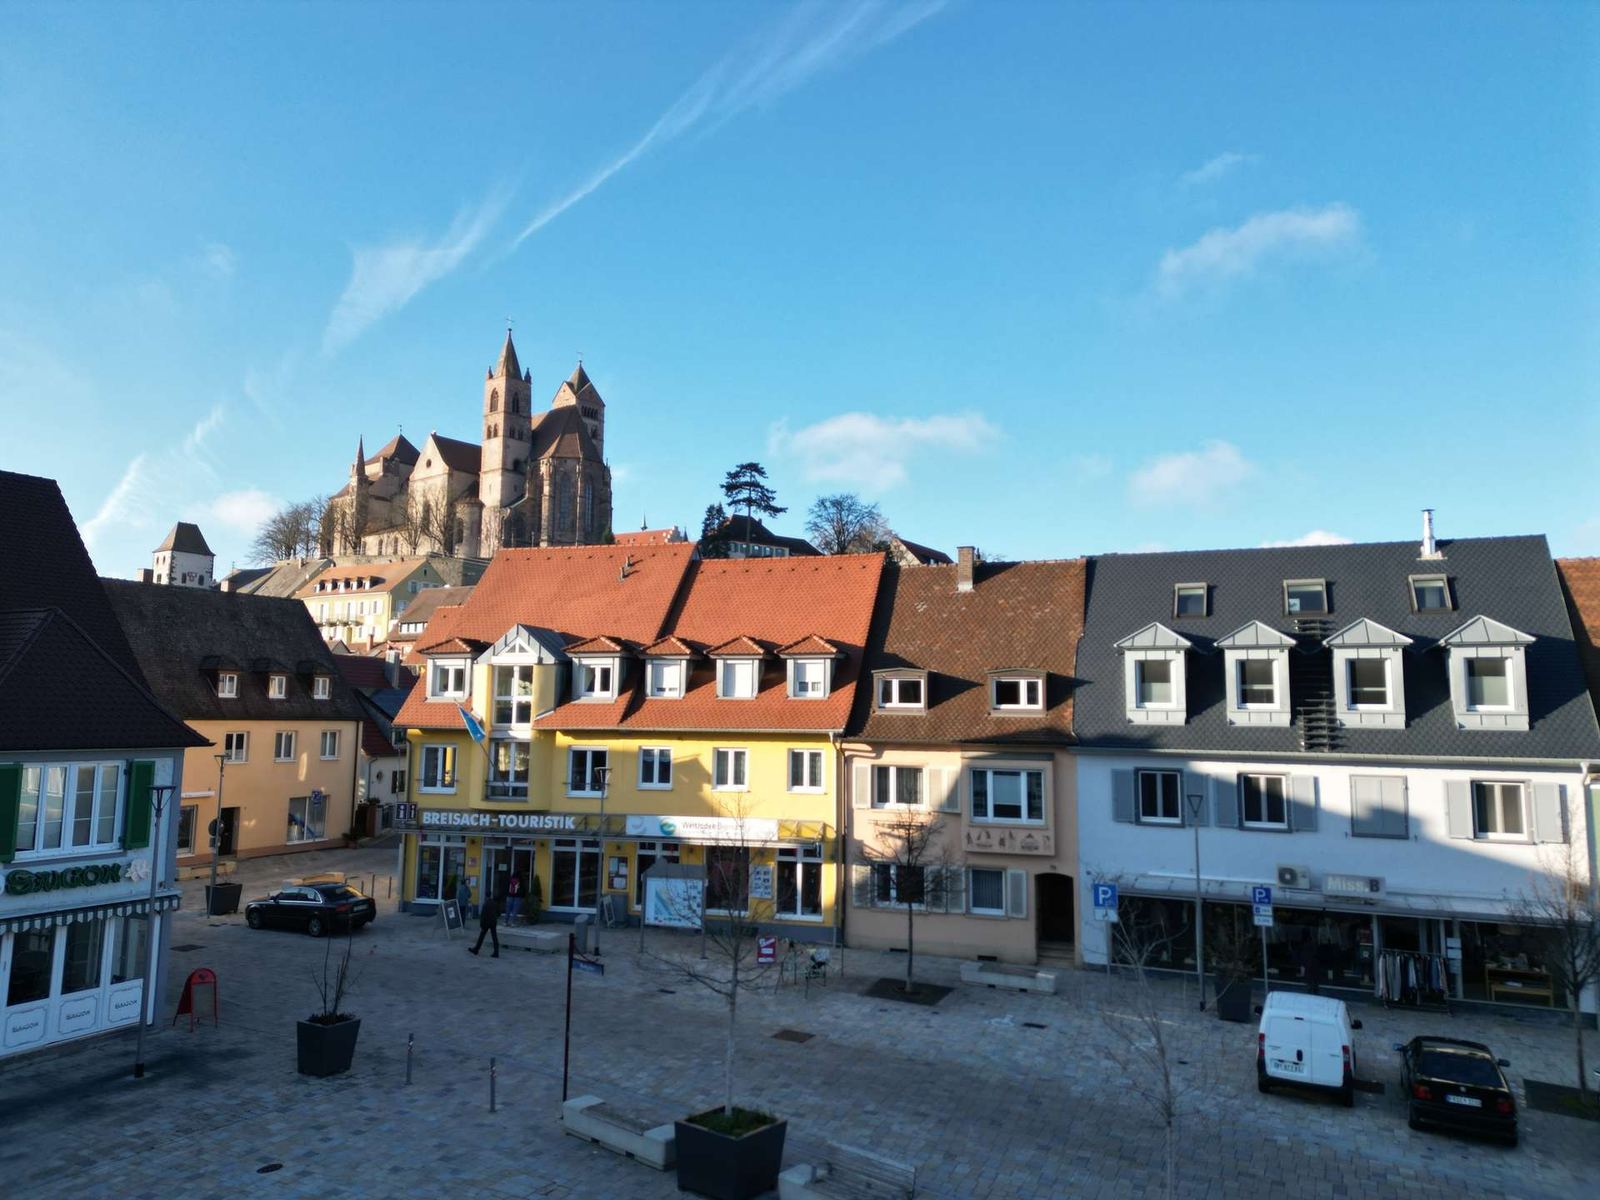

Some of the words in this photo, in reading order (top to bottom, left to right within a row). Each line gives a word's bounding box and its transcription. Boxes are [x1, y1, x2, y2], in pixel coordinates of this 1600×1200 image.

[422, 811, 575, 830] BREISACH-TOURISTIK
[5, 863, 122, 895] SAIGON
[1098, 886, 1112, 905] P
[1255, 888, 1266, 903] P
